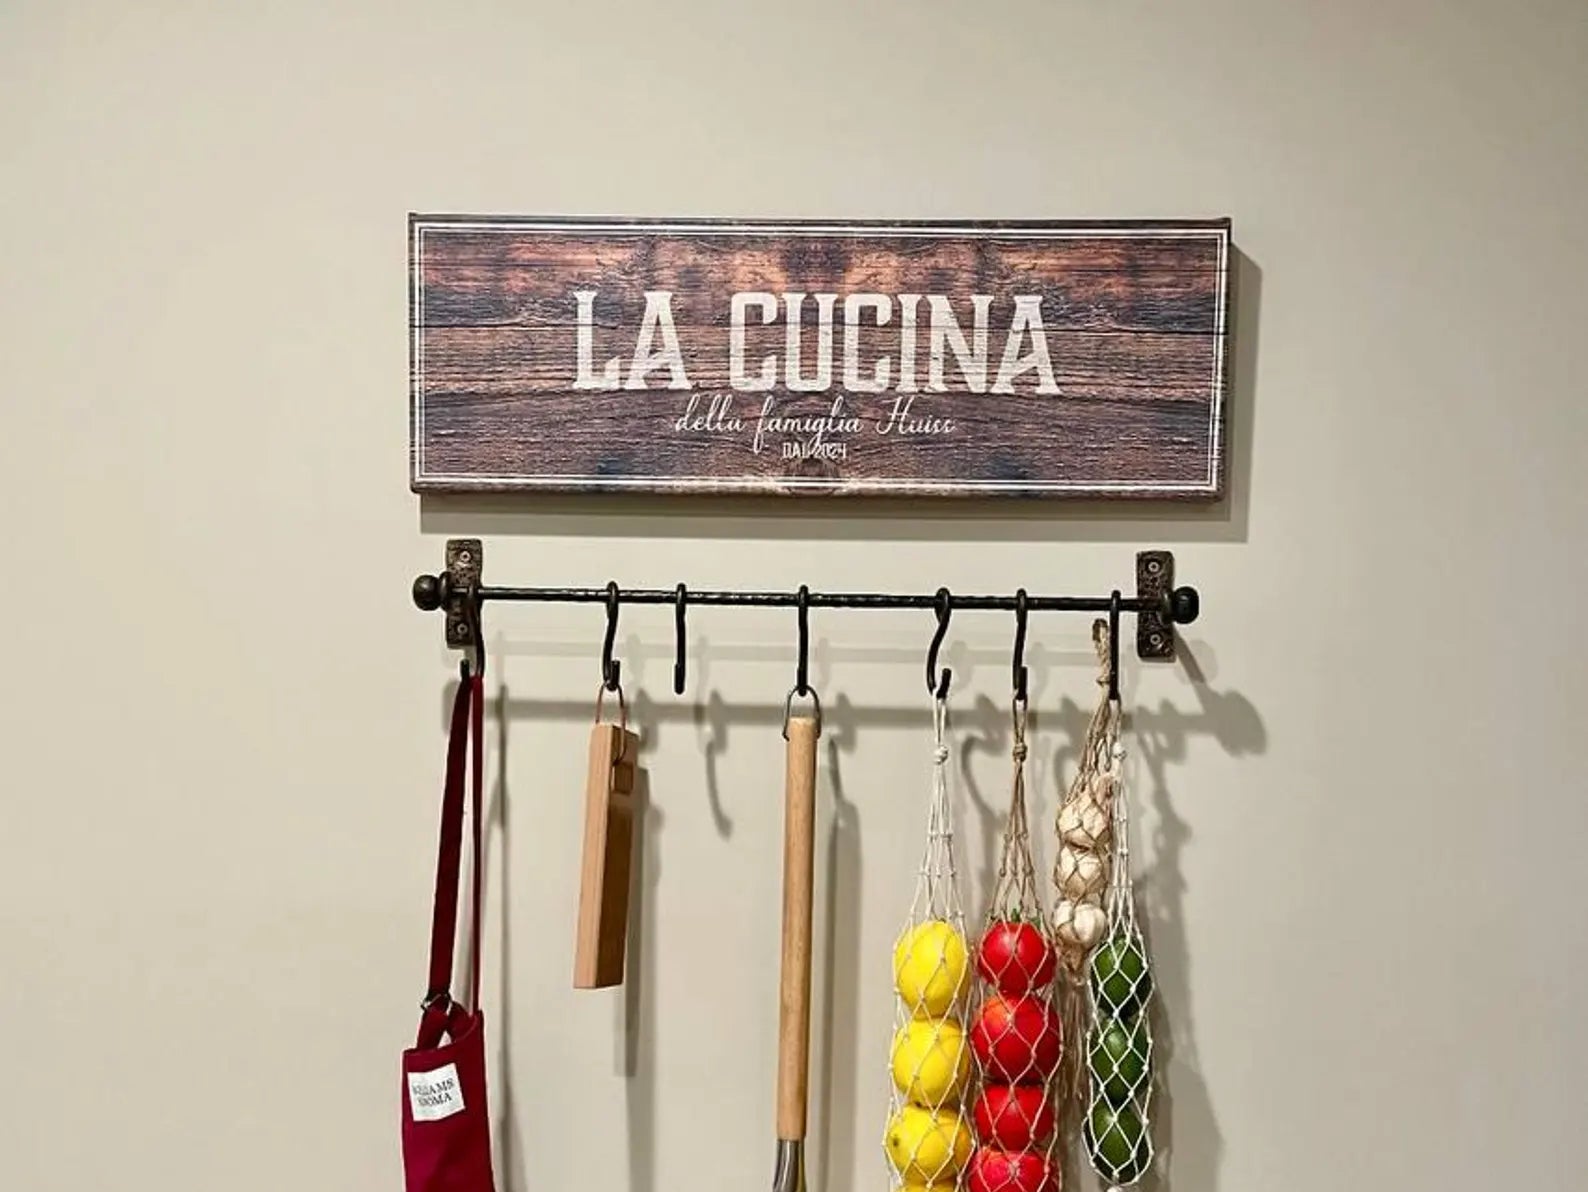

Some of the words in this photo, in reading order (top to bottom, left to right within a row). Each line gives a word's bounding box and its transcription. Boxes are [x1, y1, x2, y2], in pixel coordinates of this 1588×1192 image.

[572, 290, 693, 391] LA
[729, 291, 1064, 395] CUCINA
[675, 394, 744, 432] della
[753, 396, 863, 455] famiglia
[876, 395, 957, 435] Huiss
